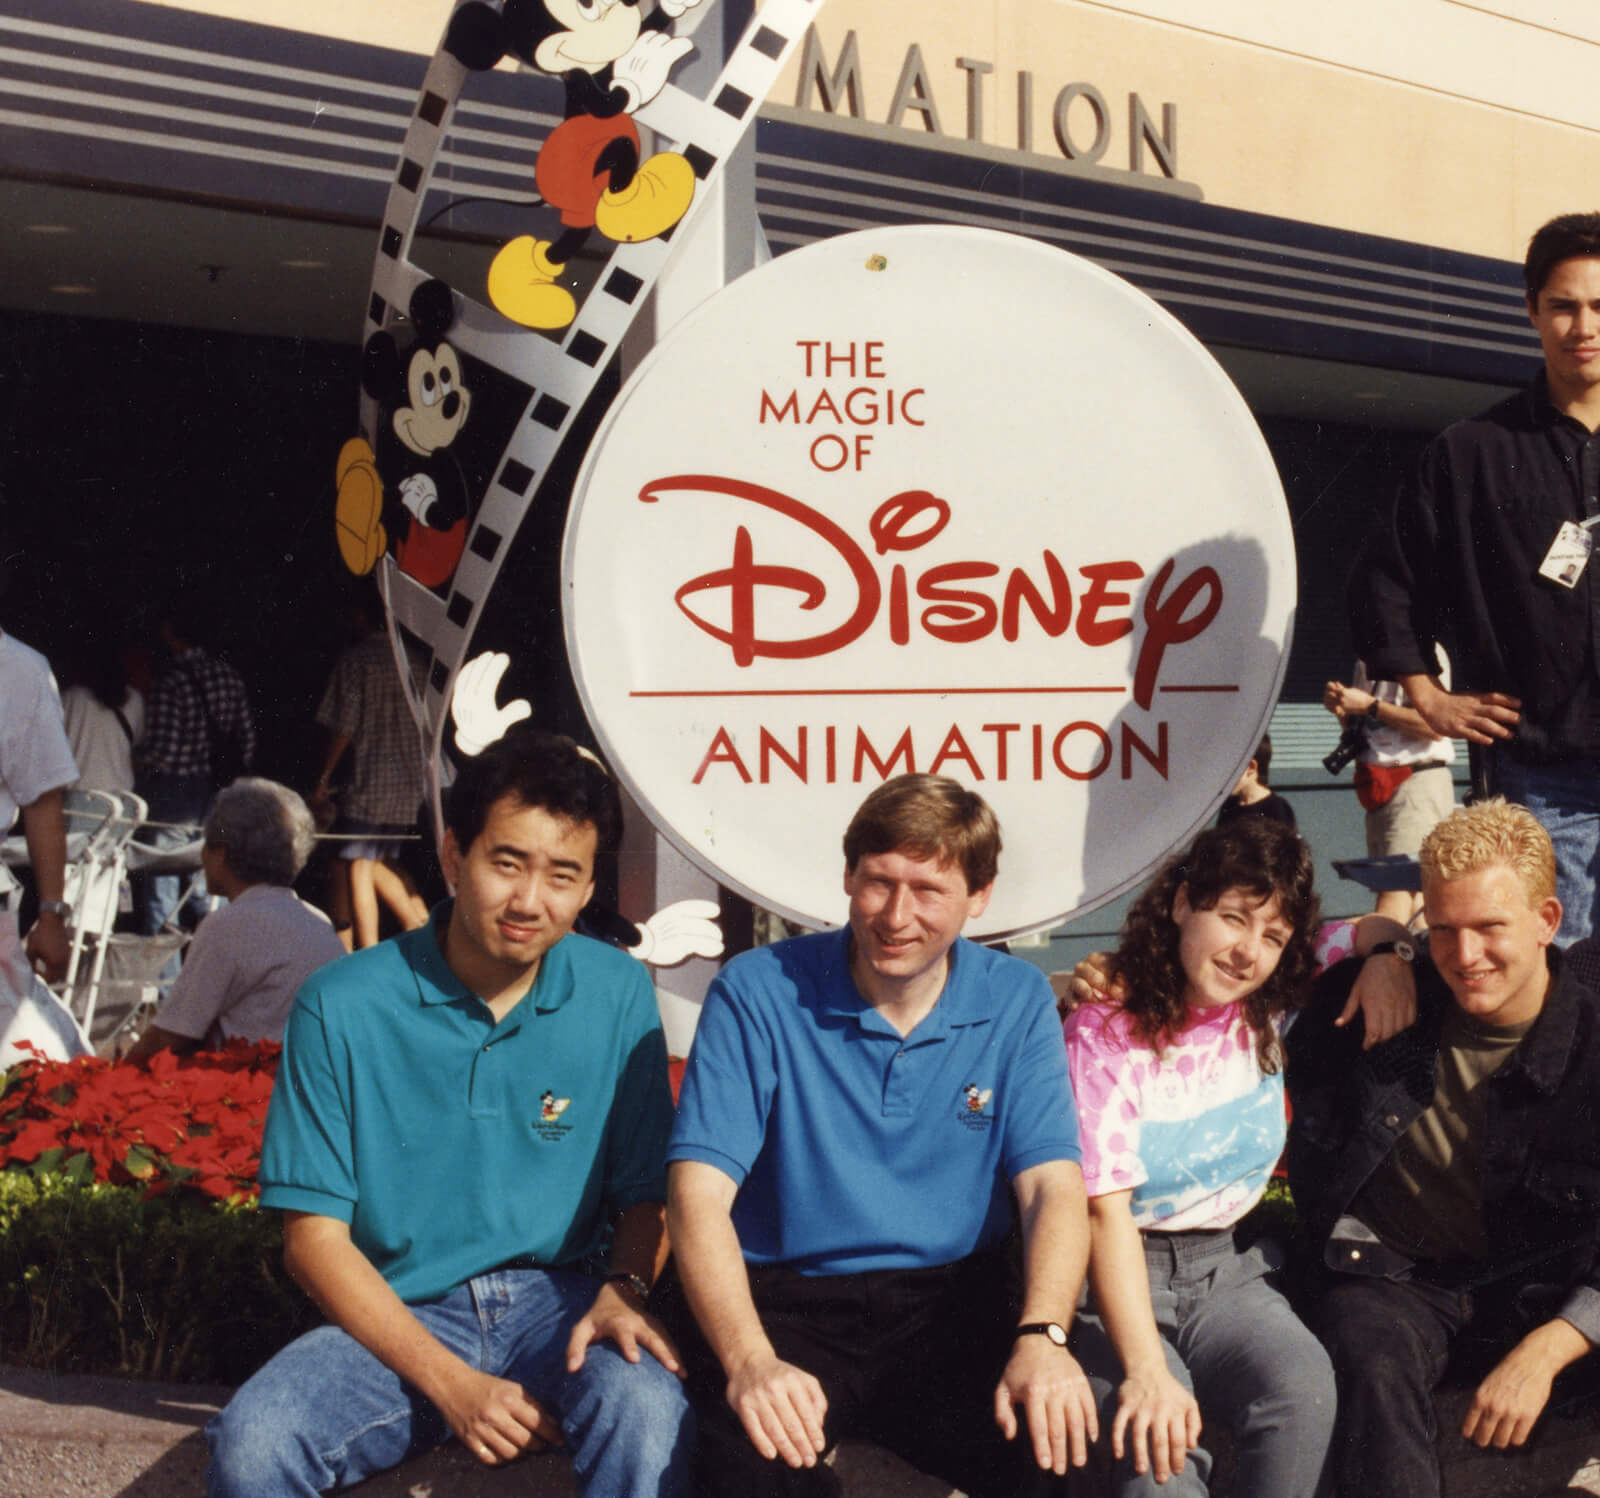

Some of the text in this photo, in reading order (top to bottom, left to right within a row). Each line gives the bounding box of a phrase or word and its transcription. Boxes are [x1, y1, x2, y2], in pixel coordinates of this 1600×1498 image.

[795, 21, 1177, 179] MATION
[796, 340, 886, 378] THE
[759, 387, 925, 427] MAGIC
[810, 434, 873, 472] OF
[638, 474, 1224, 712] Disney
[691, 720, 1169, 786] ANIMATION
